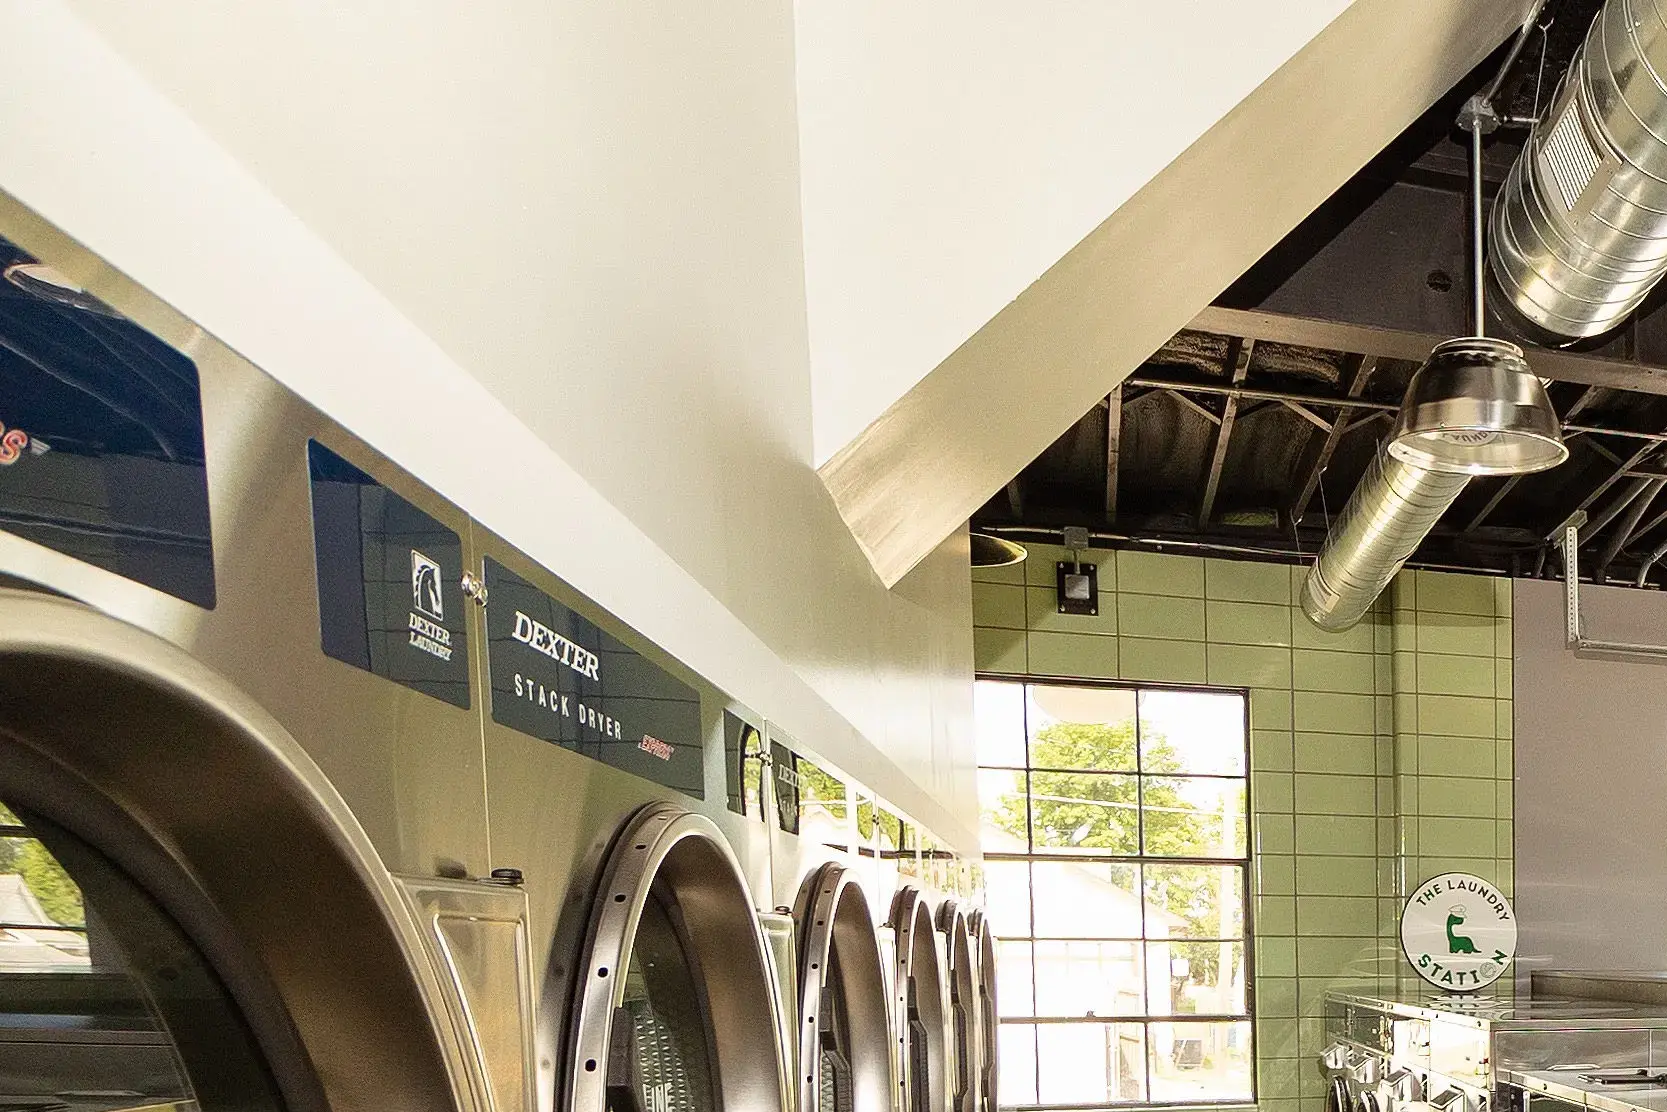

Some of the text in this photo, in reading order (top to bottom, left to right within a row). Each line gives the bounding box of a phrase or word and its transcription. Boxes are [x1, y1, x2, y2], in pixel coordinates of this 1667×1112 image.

[409, 612, 452, 647] DEXTER
[511, 611, 600, 682] DEXTER
[514, 673, 622, 740] STACK DRYER
[1416, 880, 1510, 921] THE LAUNDRY
[1418, 949, 1508, 985] STATION
